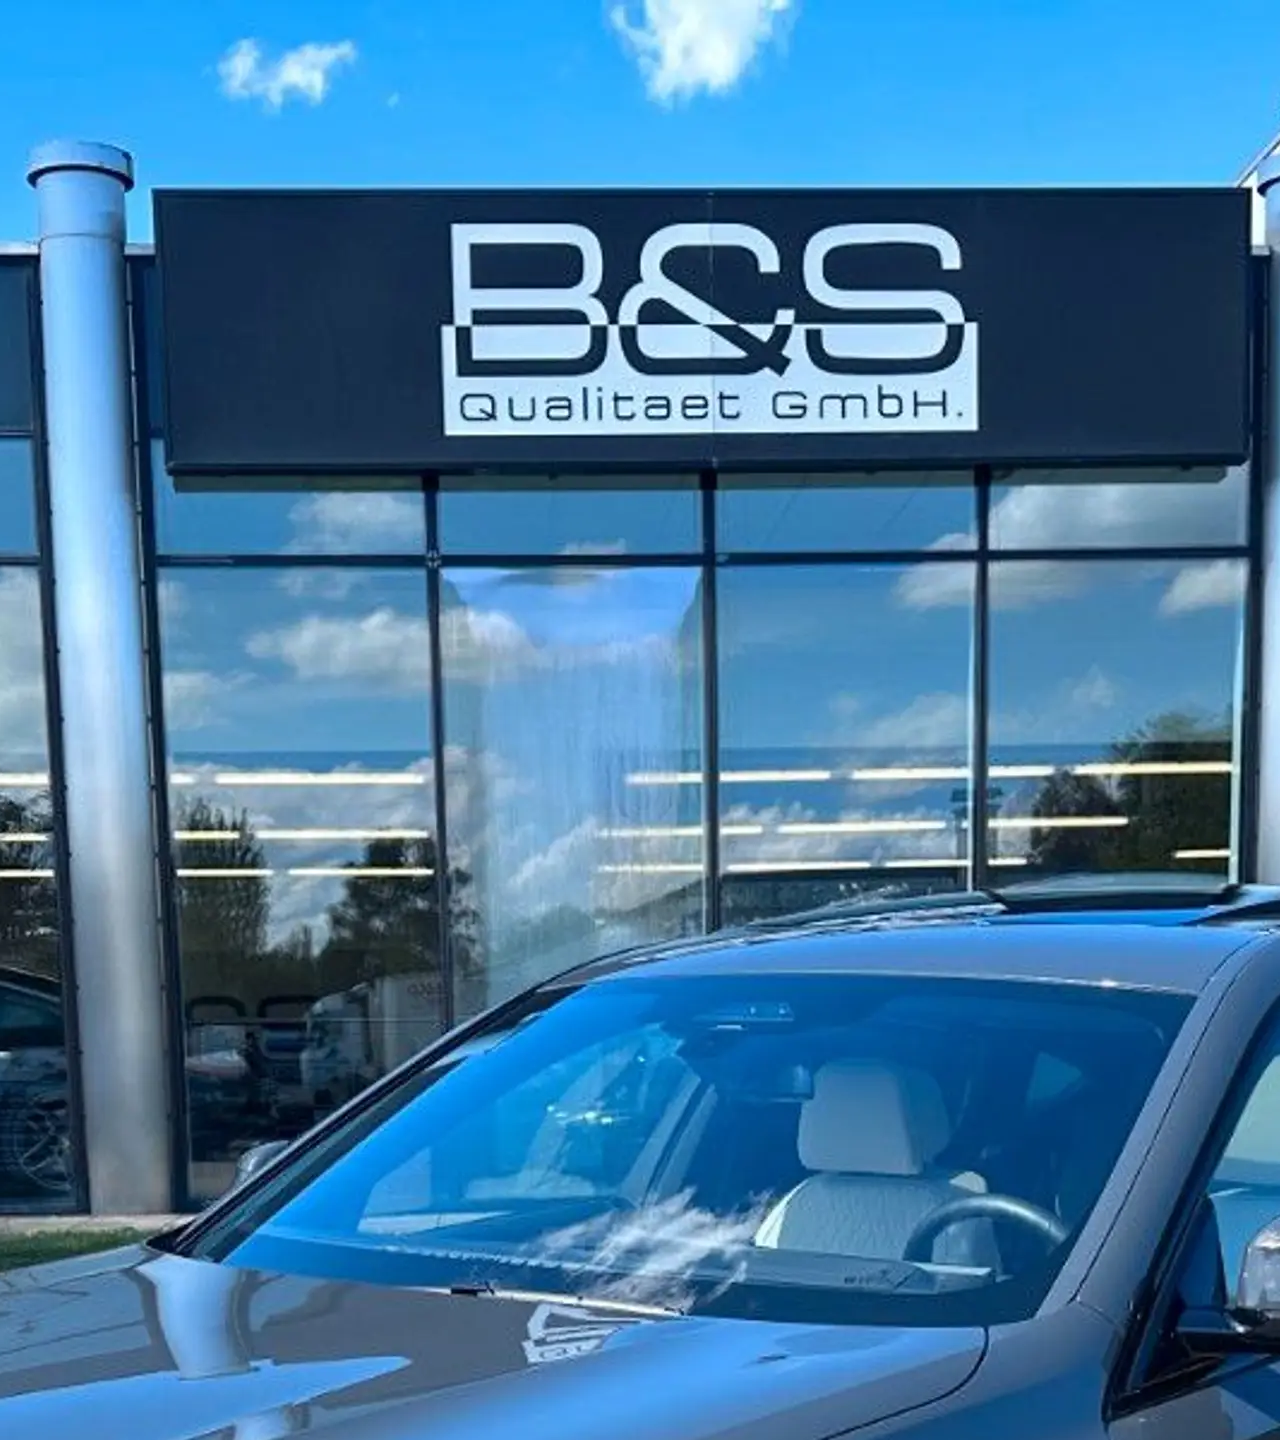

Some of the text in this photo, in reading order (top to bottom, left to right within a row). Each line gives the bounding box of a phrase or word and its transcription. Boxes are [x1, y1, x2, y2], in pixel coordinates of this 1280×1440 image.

[451, 223, 965, 377] B&S
[459, 385, 965, 421] Qualitaet GmbH.
